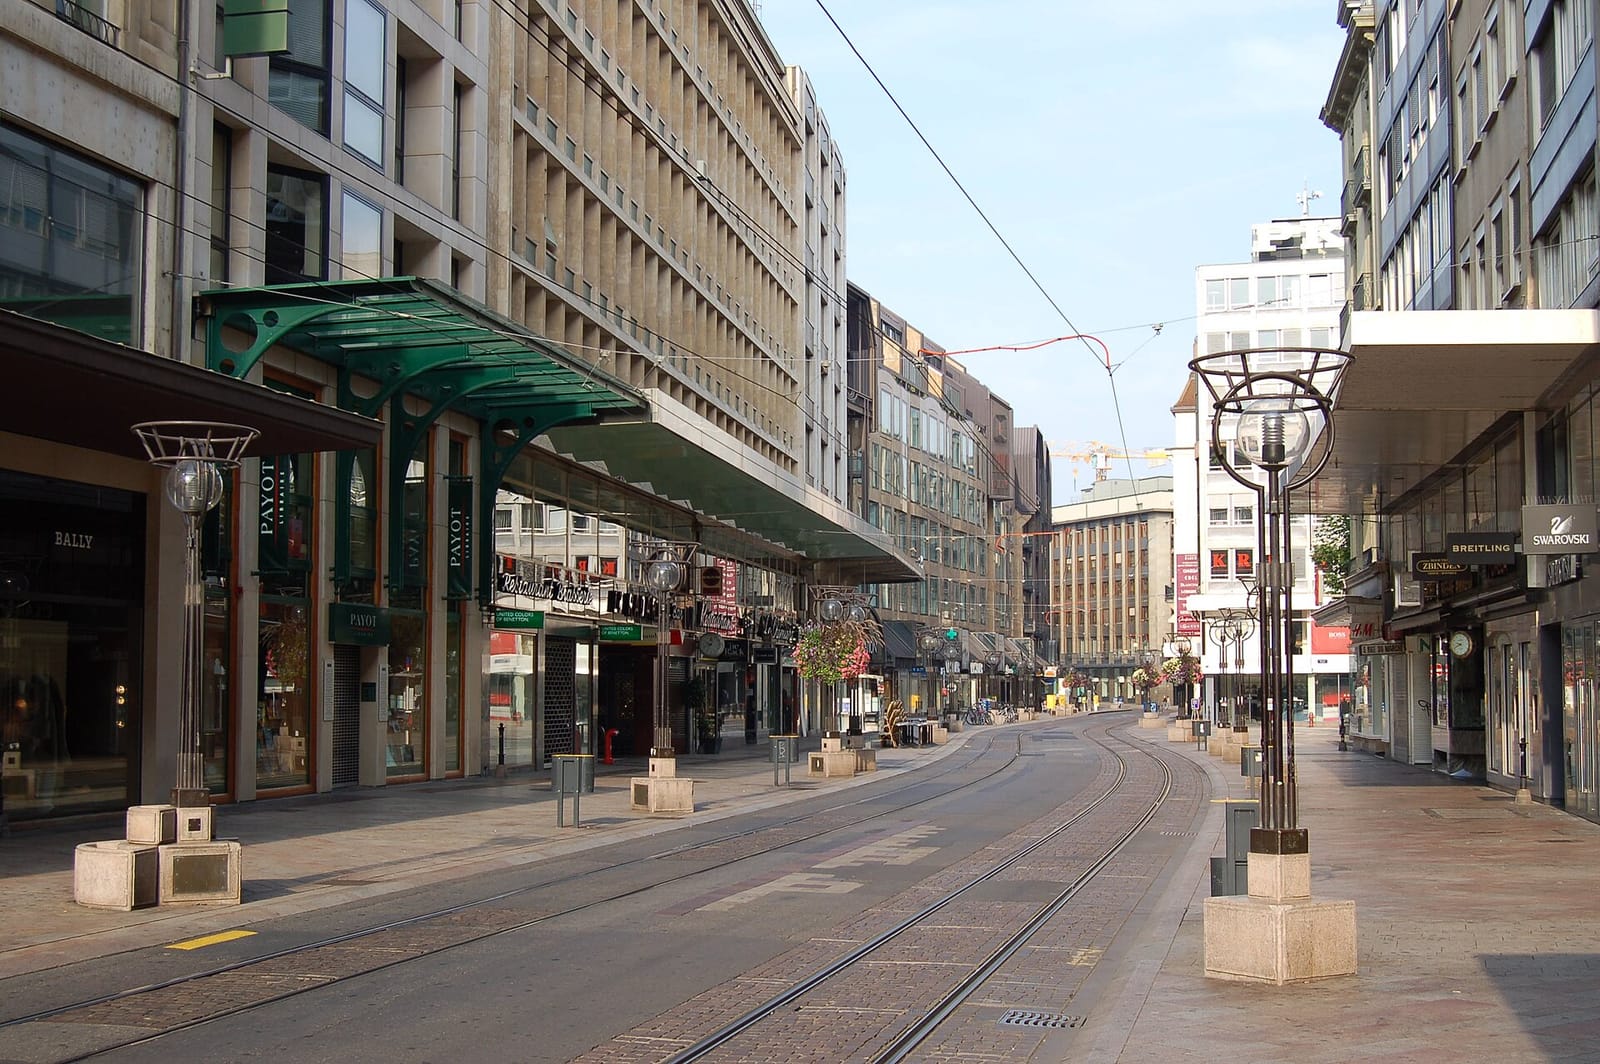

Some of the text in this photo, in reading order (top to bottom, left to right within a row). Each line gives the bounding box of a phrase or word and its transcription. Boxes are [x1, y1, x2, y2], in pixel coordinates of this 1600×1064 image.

[261, 461, 275, 535] PAYOT
[55, 531, 93, 549] BALLY
[450, 507, 461, 567] PAYOT
[1533, 534, 1590, 546] SWAROVSKI
[1452, 544, 1511, 553] BREITLING
[350, 613, 376, 628] PAYOT
